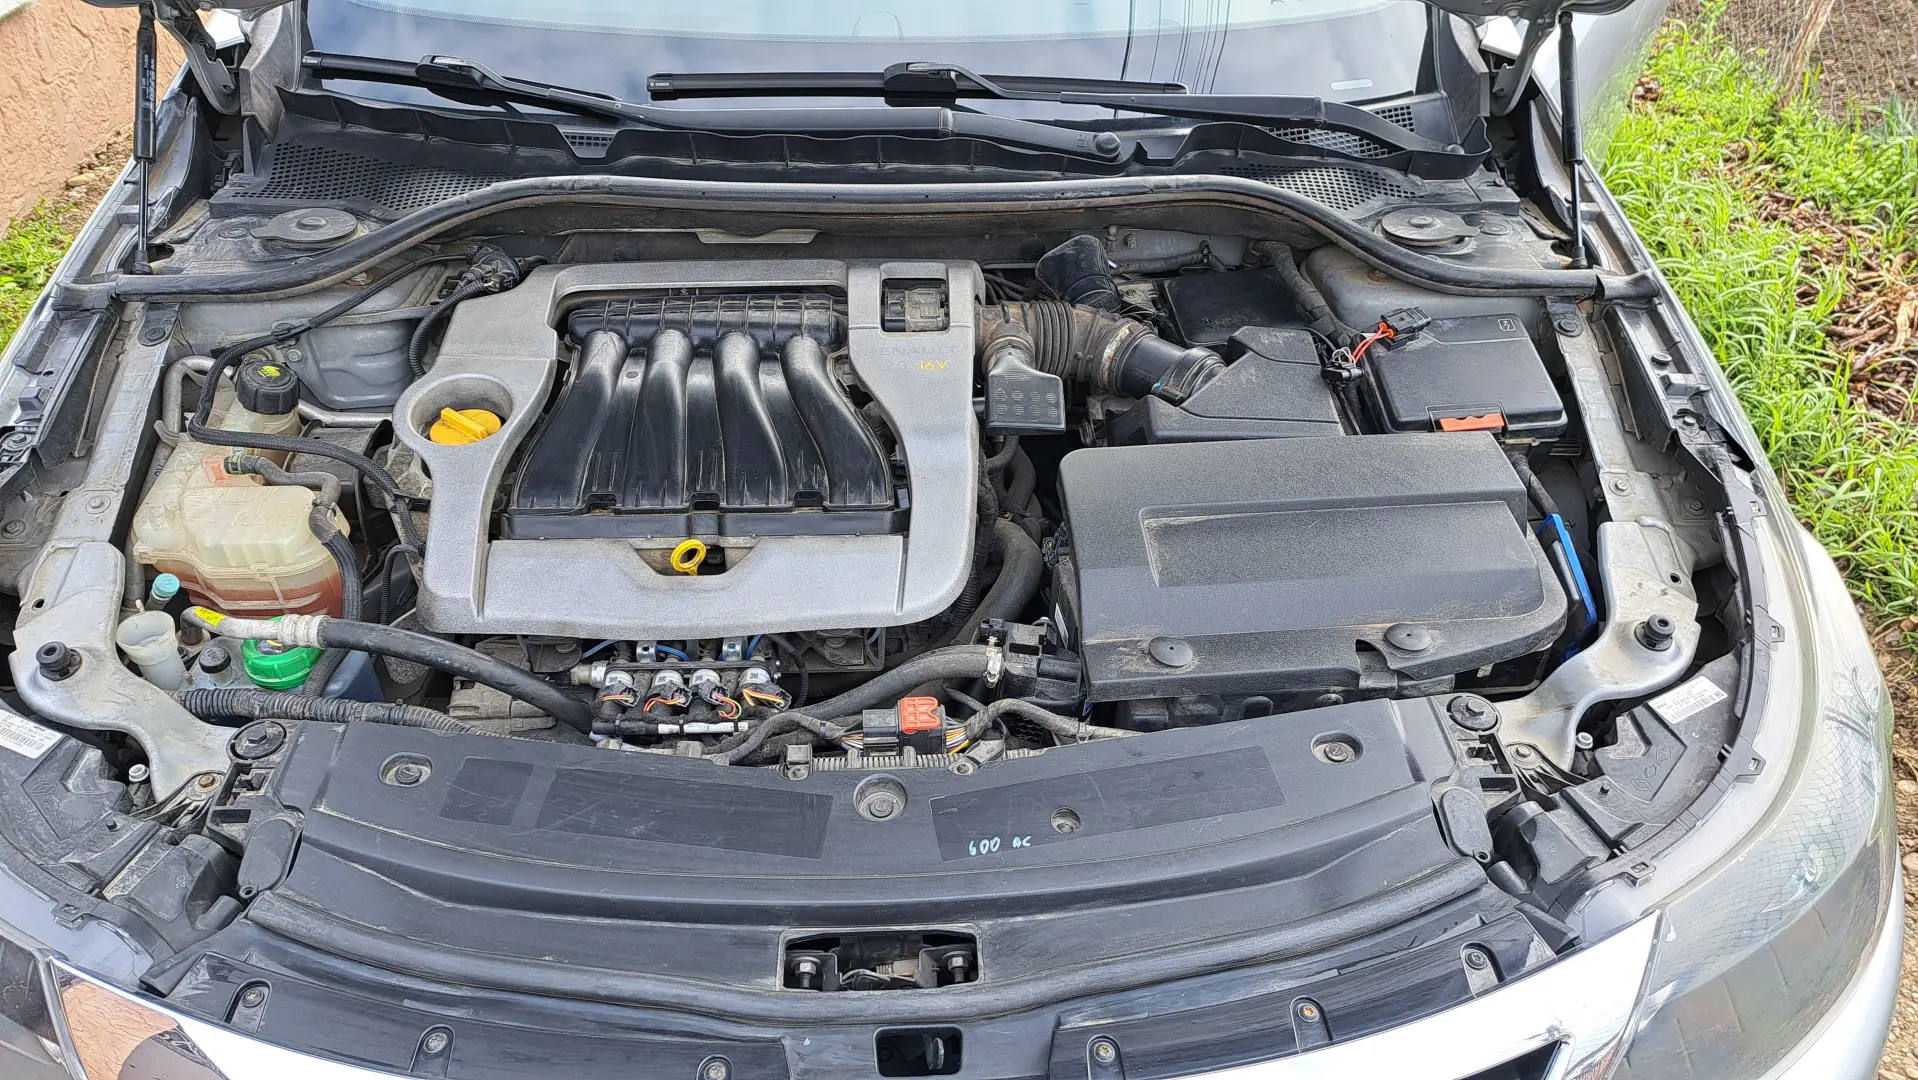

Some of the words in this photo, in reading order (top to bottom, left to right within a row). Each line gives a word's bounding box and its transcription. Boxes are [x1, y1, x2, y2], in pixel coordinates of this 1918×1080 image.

[871, 345, 960, 356] ENAULT
[920, 359, 950, 371] 16V
[968, 836, 1001, 856] 600
[1012, 835, 1032, 849] AC
